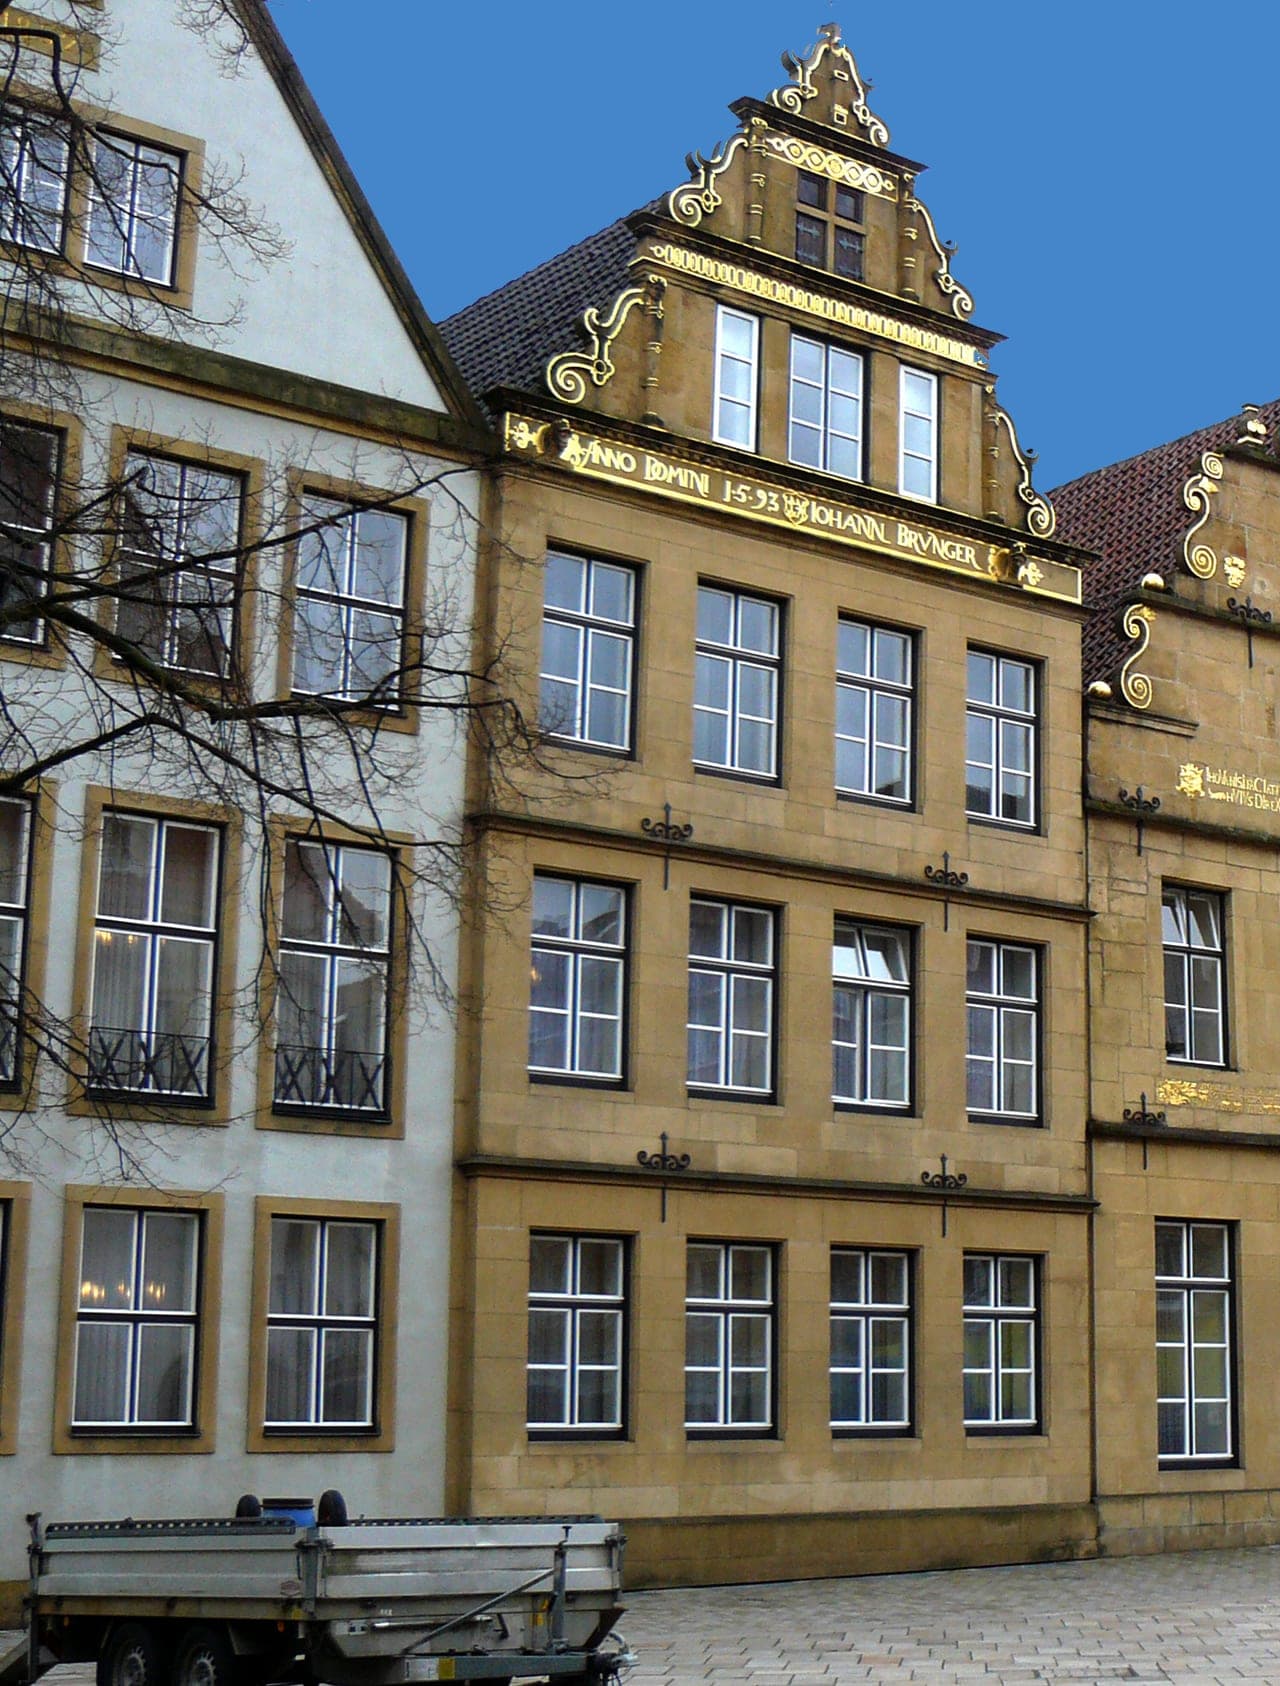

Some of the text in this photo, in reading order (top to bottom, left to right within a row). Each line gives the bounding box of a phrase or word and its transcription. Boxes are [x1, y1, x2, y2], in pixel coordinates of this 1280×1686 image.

[578, 440, 638, 473] ANNO
[643, 454, 711, 498] DOMINI
[810, 501, 891, 544] IOHANN
[897, 523, 984, 571] BRVNGER
